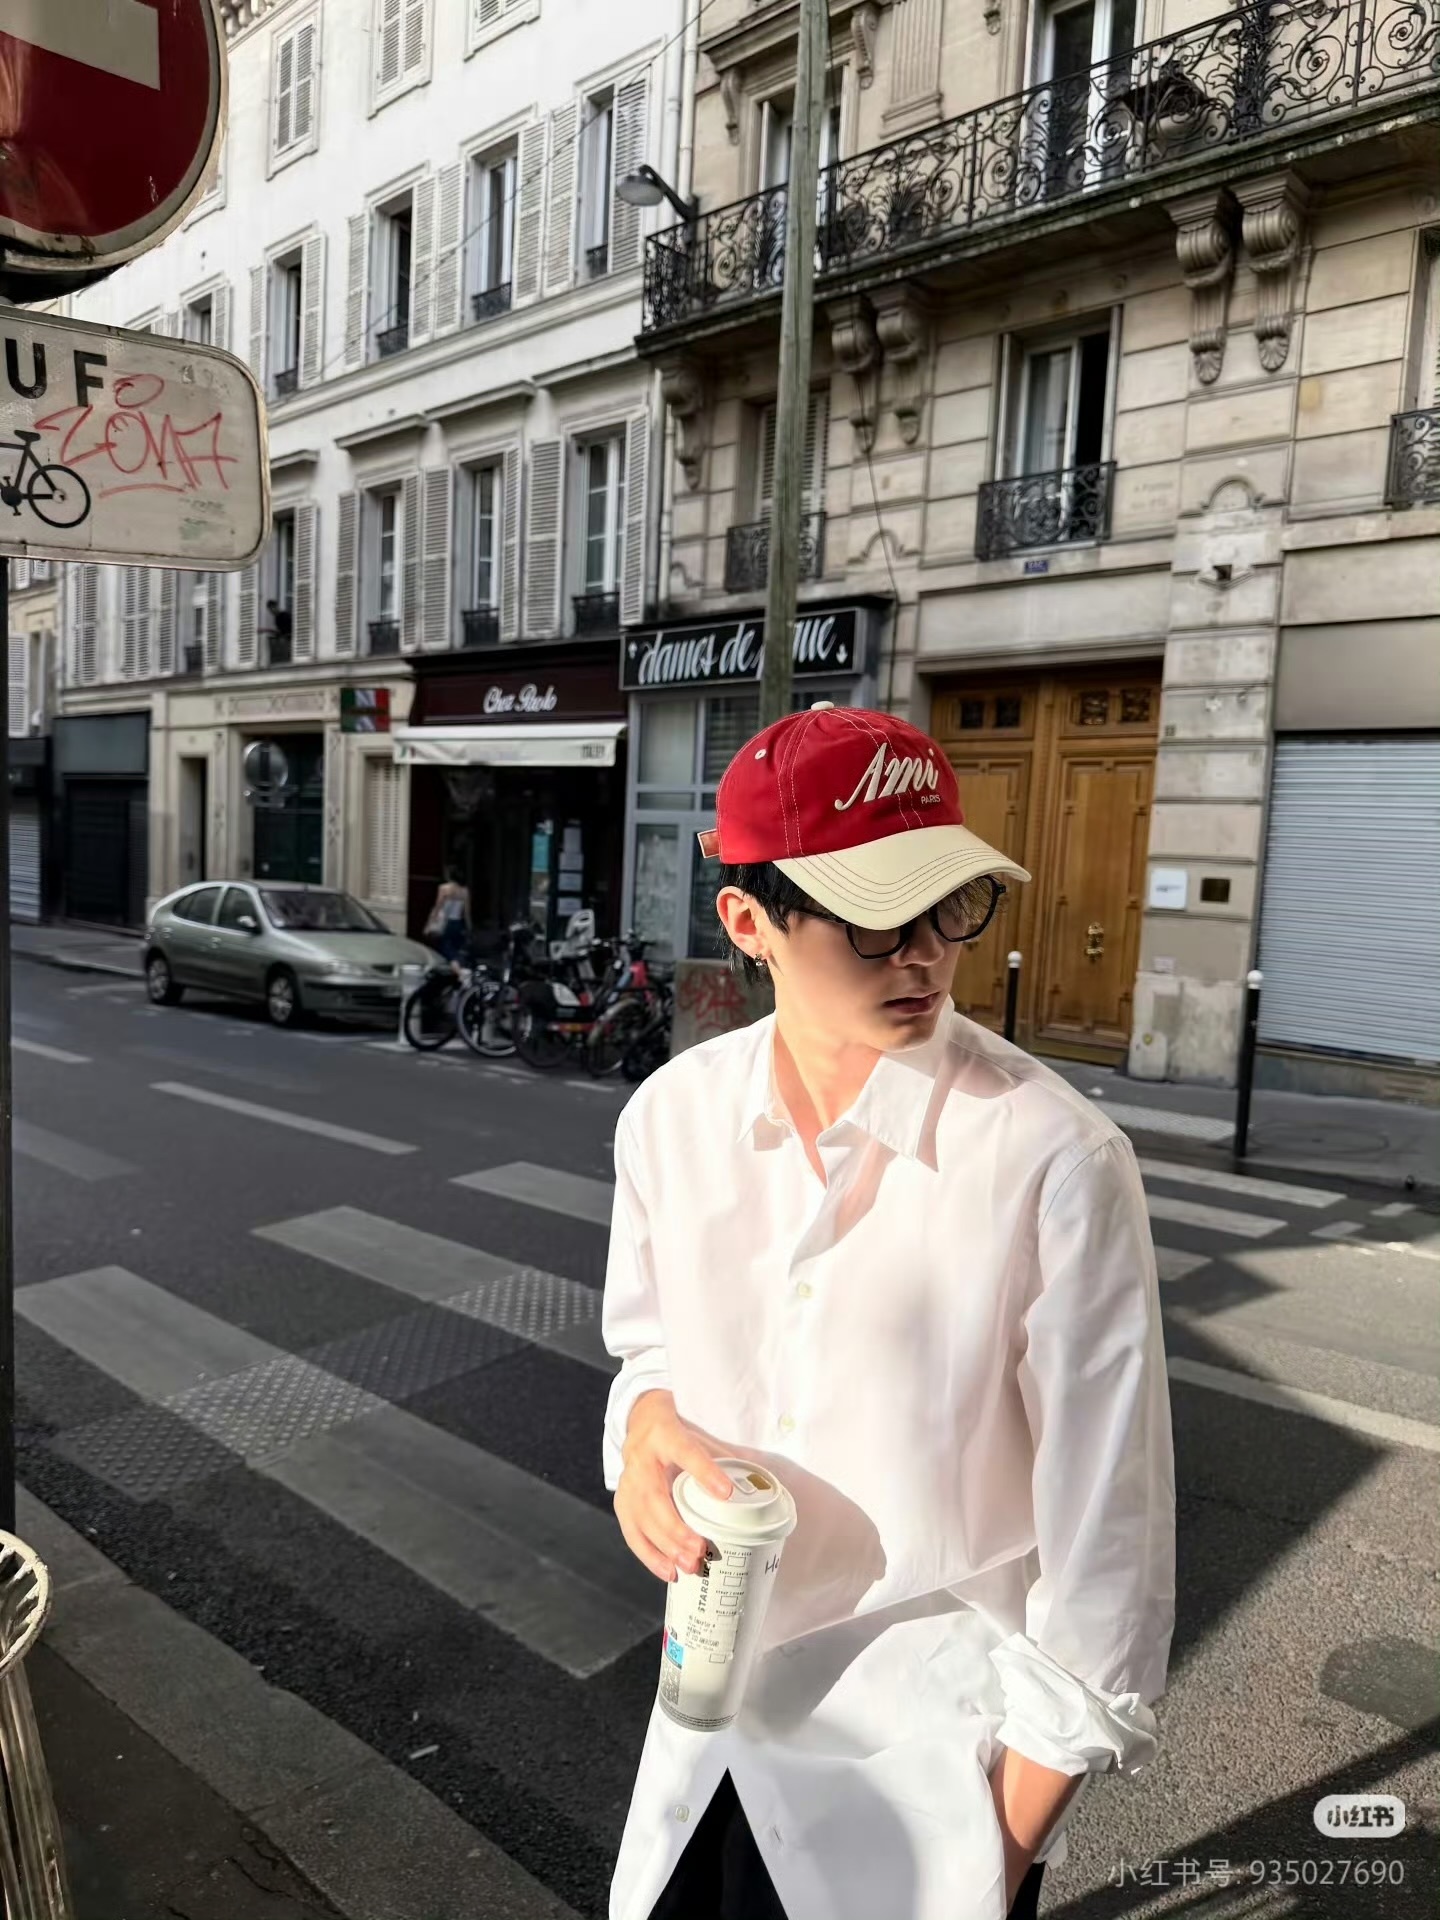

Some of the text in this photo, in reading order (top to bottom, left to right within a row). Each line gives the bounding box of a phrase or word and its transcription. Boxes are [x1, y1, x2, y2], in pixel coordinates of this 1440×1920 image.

[719, 621, 756, 676] de
[834, 742, 939, 811] Ami
[921, 794, 941, 804] PARIS
